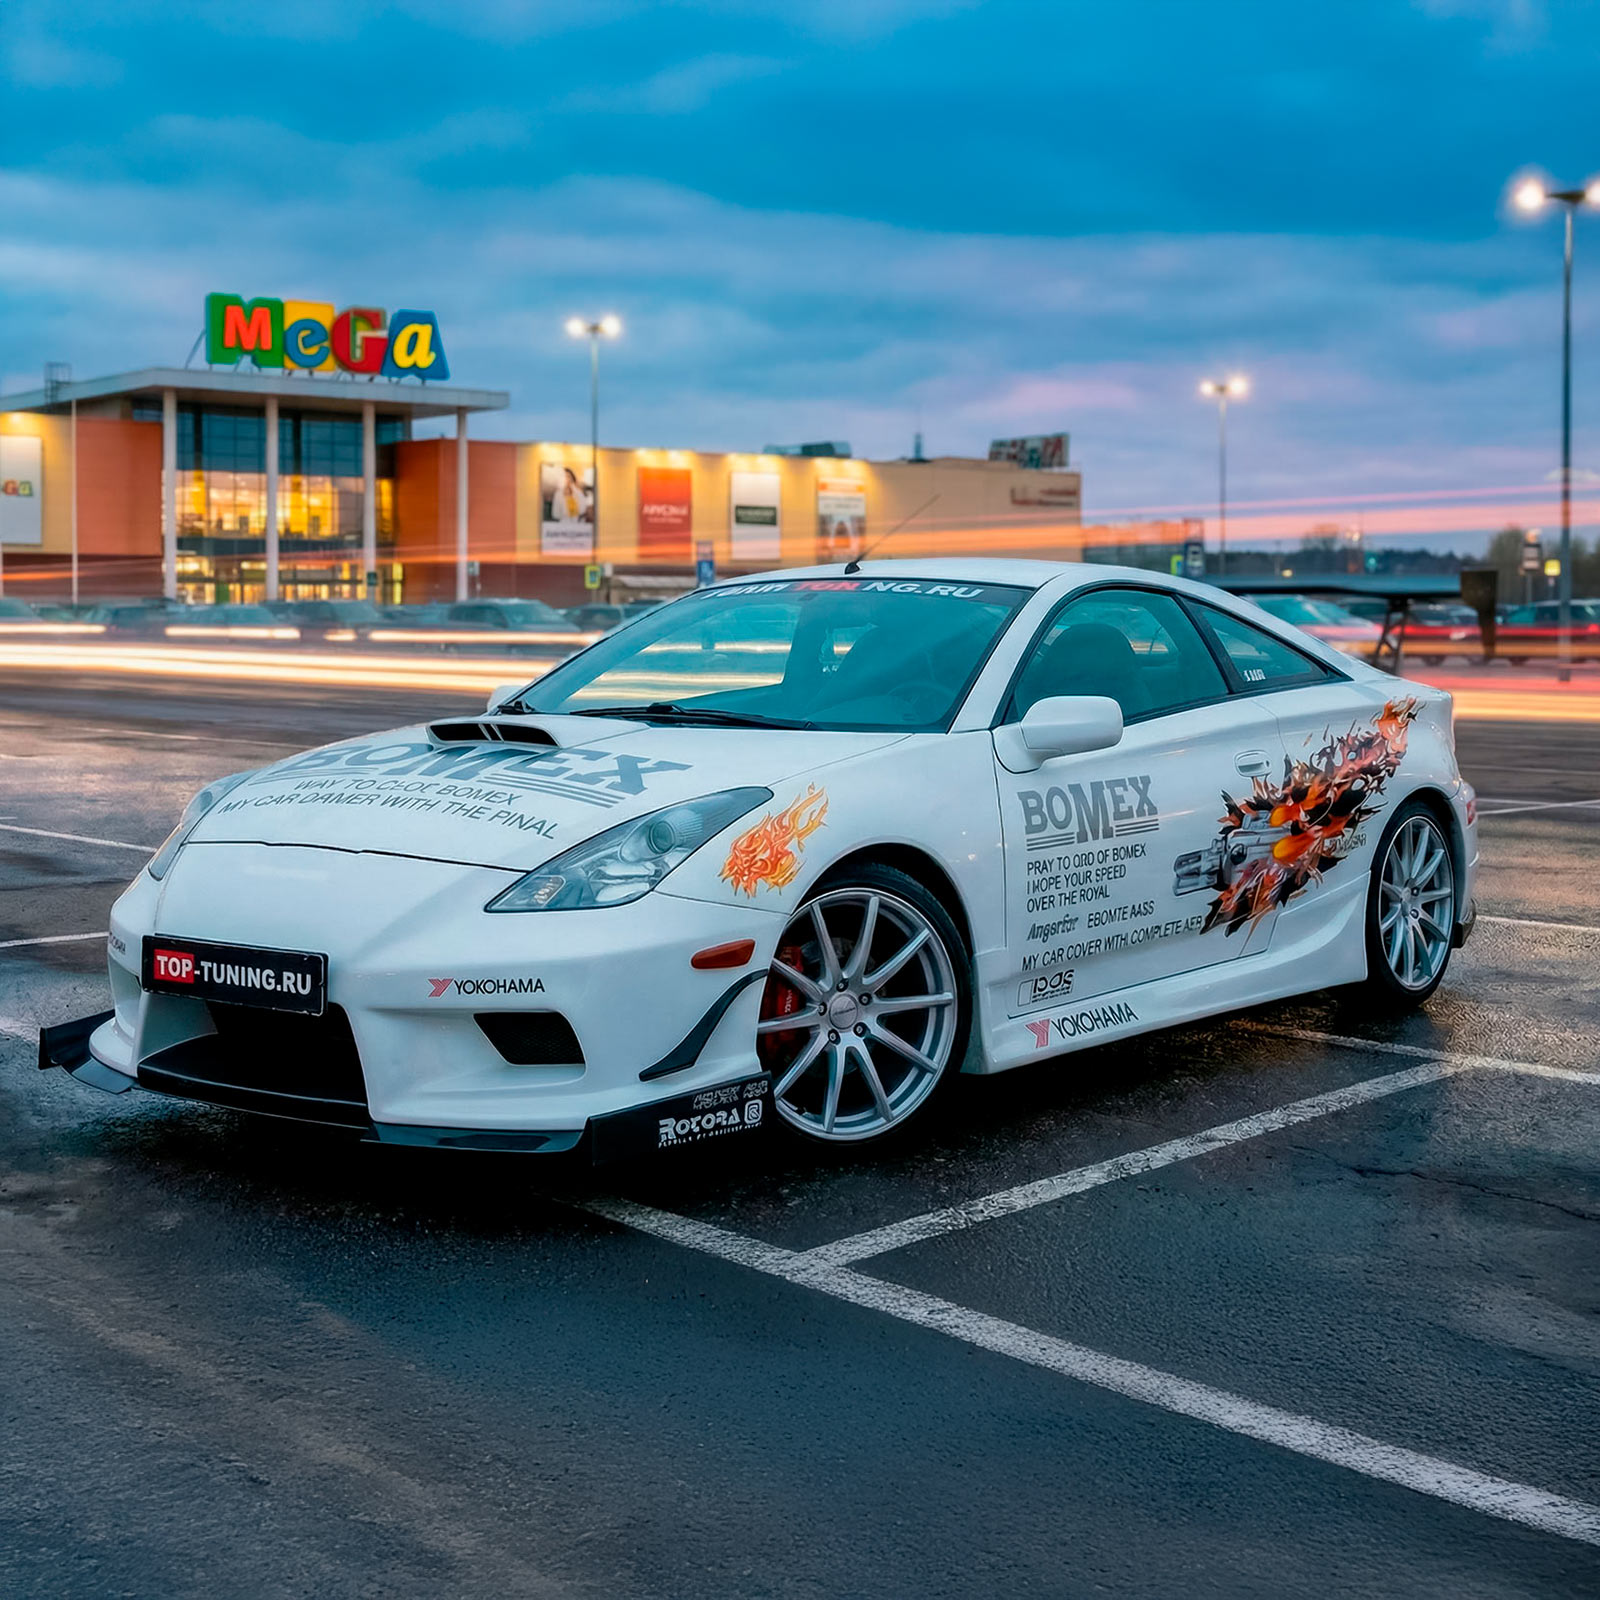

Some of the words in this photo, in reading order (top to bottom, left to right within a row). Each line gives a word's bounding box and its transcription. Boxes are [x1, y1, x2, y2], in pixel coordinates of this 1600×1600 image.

[264, 743, 693, 796] BOMEX
[294, 778, 345, 791] WAY
[349, 778, 376, 791] TO
[436, 784, 523, 806] BOMEX
[1017, 775, 1158, 844] BOMEX
[218, 799, 255, 815] MY
[254, 793, 300, 807] CAR
[380, 794, 440, 812] WITH
[442, 801, 491, 820] THE
[488, 809, 559, 840] PINAL
[1027, 858, 1055, 876] PRAY
[1057, 855, 1071, 871] TO
[1096, 849, 1110, 865] OF
[1112, 843, 1147, 862] BOMEX
[1026, 880, 1031, 895] I
[1032, 875, 1061, 893] HOPE
[1063, 870, 1093, 889] YOUR
[1095, 864, 1127, 883] SPEED
[1026, 895, 1056, 913] OVER
[1058, 890, 1077, 907] THE
[1079, 884, 1110, 903] ROYAL
[1022, 955, 1040, 971] MY
[1042, 947, 1064, 966] CAR
[1066, 939, 1101, 961] COVER
[1130, 919, 1182, 945] COMPLETE
[156, 954, 312, 995] TOP-TUNING.RU
[454, 978, 545, 995] YOKOHAMA
[1051, 1002, 1139, 1039] YOKOHAMA
